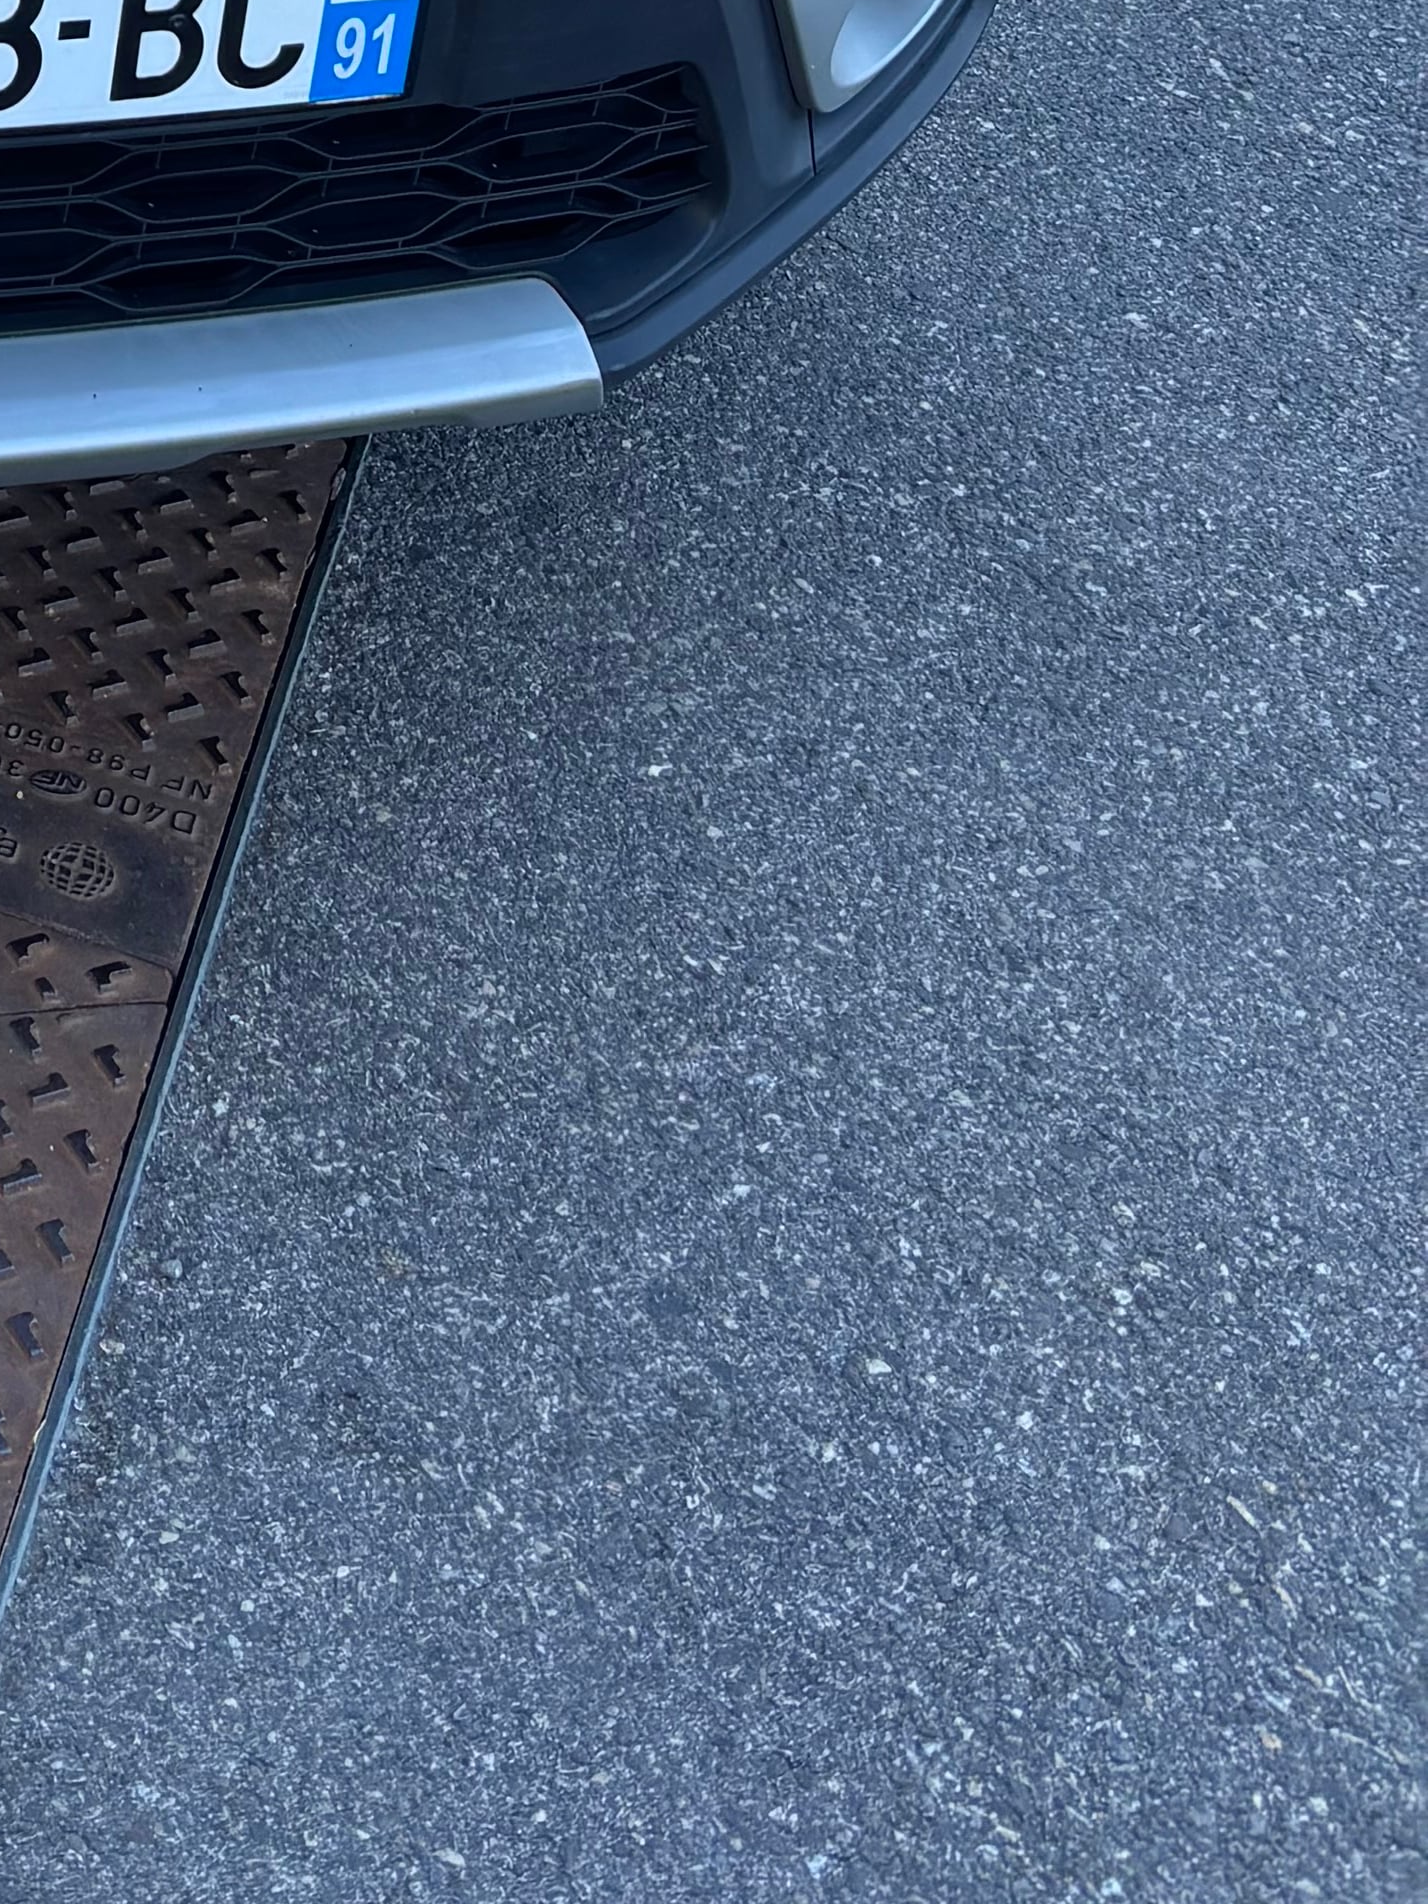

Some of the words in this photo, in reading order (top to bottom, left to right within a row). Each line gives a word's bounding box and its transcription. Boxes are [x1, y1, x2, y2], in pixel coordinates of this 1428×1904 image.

[333, 13, 396, 79] 91
[30, 771, 84, 792] NF
[161, 775, 213, 801] NF
[94, 787, 197, 835] D400
